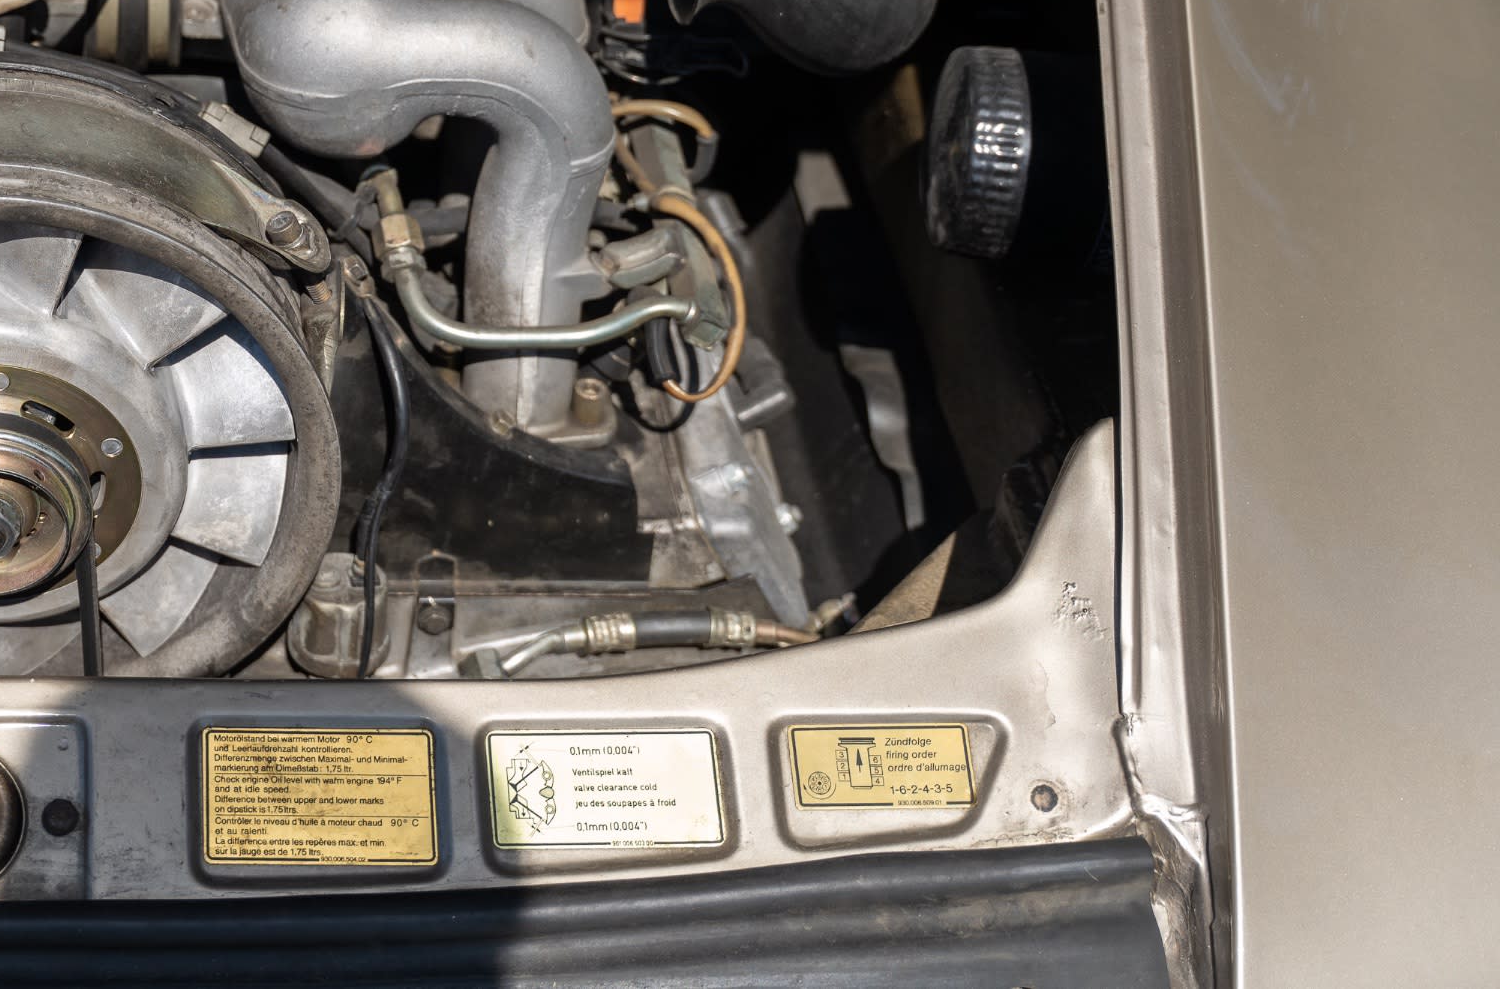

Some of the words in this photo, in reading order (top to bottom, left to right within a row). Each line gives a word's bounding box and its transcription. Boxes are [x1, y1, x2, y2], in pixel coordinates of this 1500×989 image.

[885, 737, 932, 747] Zündfolge
[232, 745, 298, 753] Leerlaufdrehzahl
[215, 755, 277, 764] Differenzmenge
[886, 751, 909, 760] firing
[912, 751, 937, 759] order
[214, 765, 259, 773] markierung
[888, 764, 913, 772] ordre
[916, 763, 966, 772] d'allumage
[572, 768, 614, 777] Ventilspiel
[242, 777, 269, 785] engine
[271, 776, 283, 784] Oil
[347, 778, 373, 786] engine
[264, 786, 291, 794] speed.
[574, 784, 594, 792] valve
[597, 784, 637, 792] clearance
[890, 783, 953, 795] 1-6-2-4-3-5
[575, 800, 588, 809] jeu
[607, 800, 647, 808] soupapes
[650, 799, 655, 807] à
[227, 806, 256, 814] dipstick
[215, 817, 252, 825] Contrôler
[292, 818, 319, 826] d'huile
[391, 819, 408, 827] 90°
[412, 819, 419, 827] C
[306, 838, 336, 847] repères
[370, 839, 386, 847] min.
[239, 848, 261, 856] jauge
